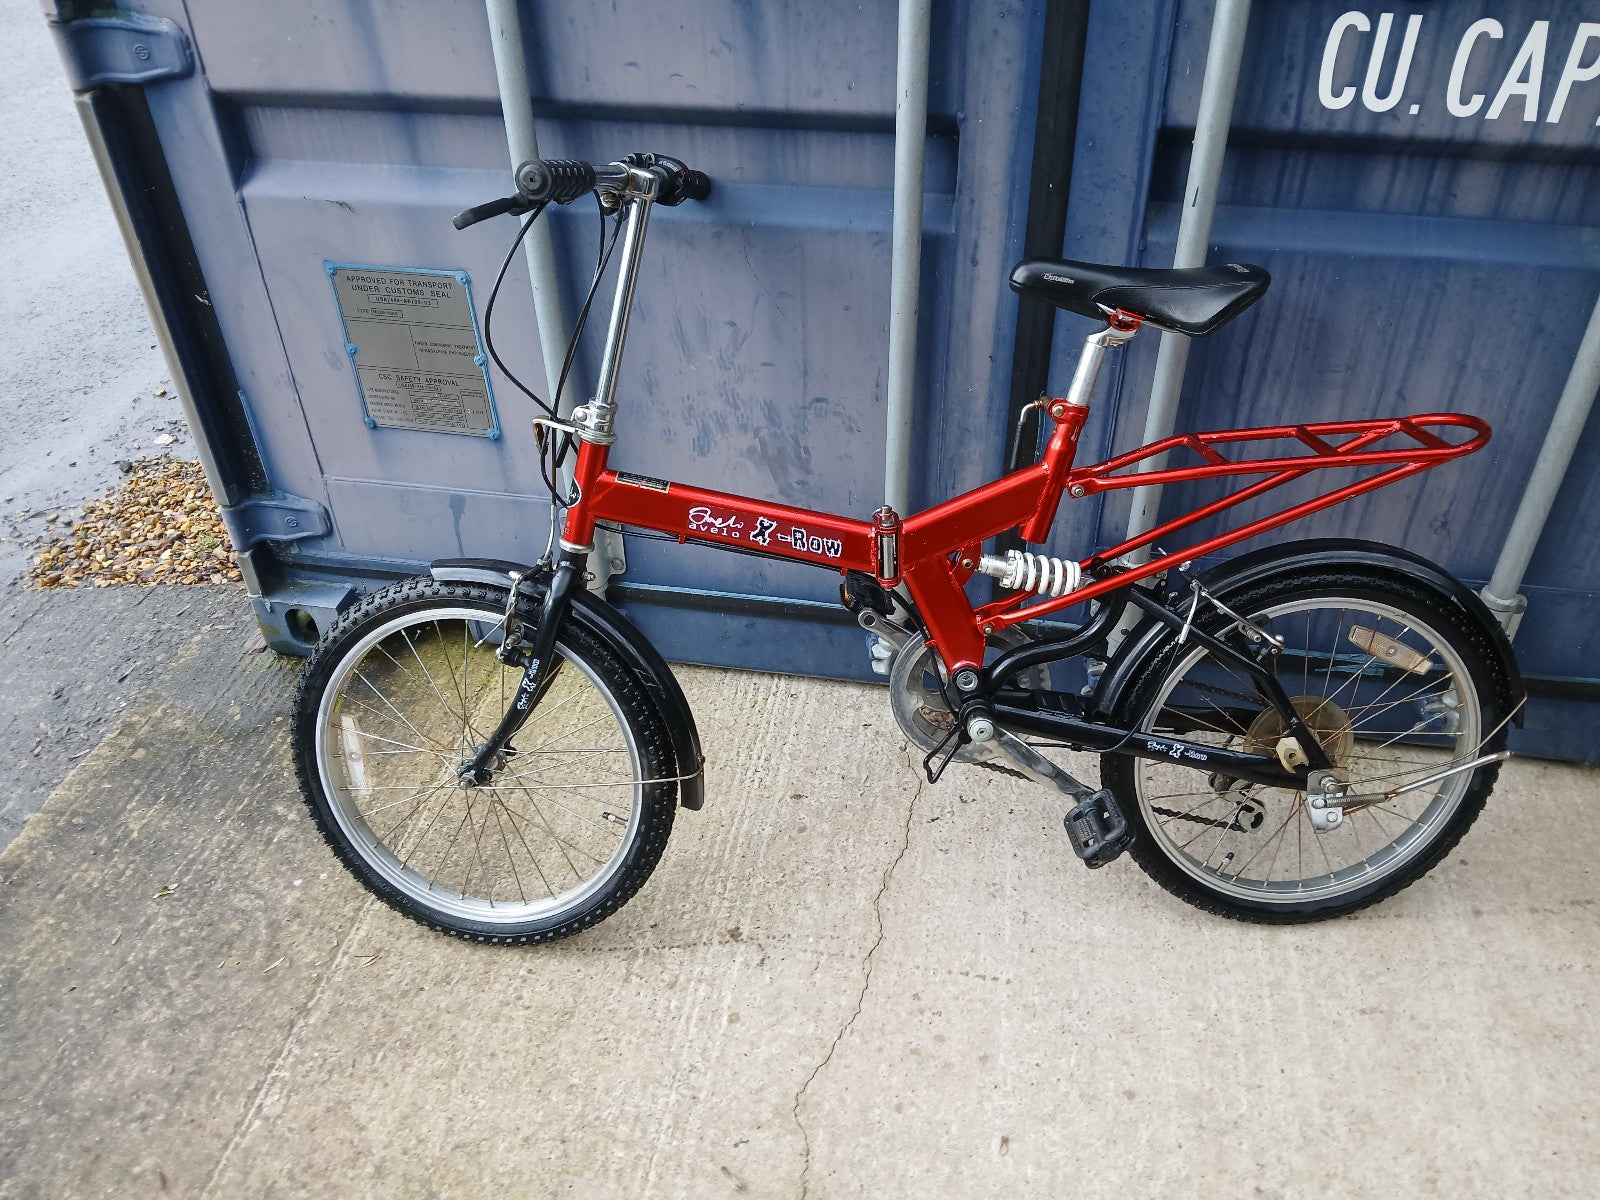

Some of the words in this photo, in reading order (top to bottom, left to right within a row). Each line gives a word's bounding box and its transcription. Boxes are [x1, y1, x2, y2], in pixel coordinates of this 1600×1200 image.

[1318, 10, 1424, 115] CU.
[346, 275, 386, 286] APPROVED
[389, 278, 405, 287] FOR
[408, 279, 453, 290] TRANSPORT
[351, 284, 381, 293] UNDER
[385, 286, 425, 297] CUSTOMS
[430, 290, 452, 299] SEAL
[378, 373, 393, 381] CSC
[395, 374, 421, 383] SAFETY
[425, 377, 460, 387] APPROVAL
[688, 523, 740, 538] avelo
